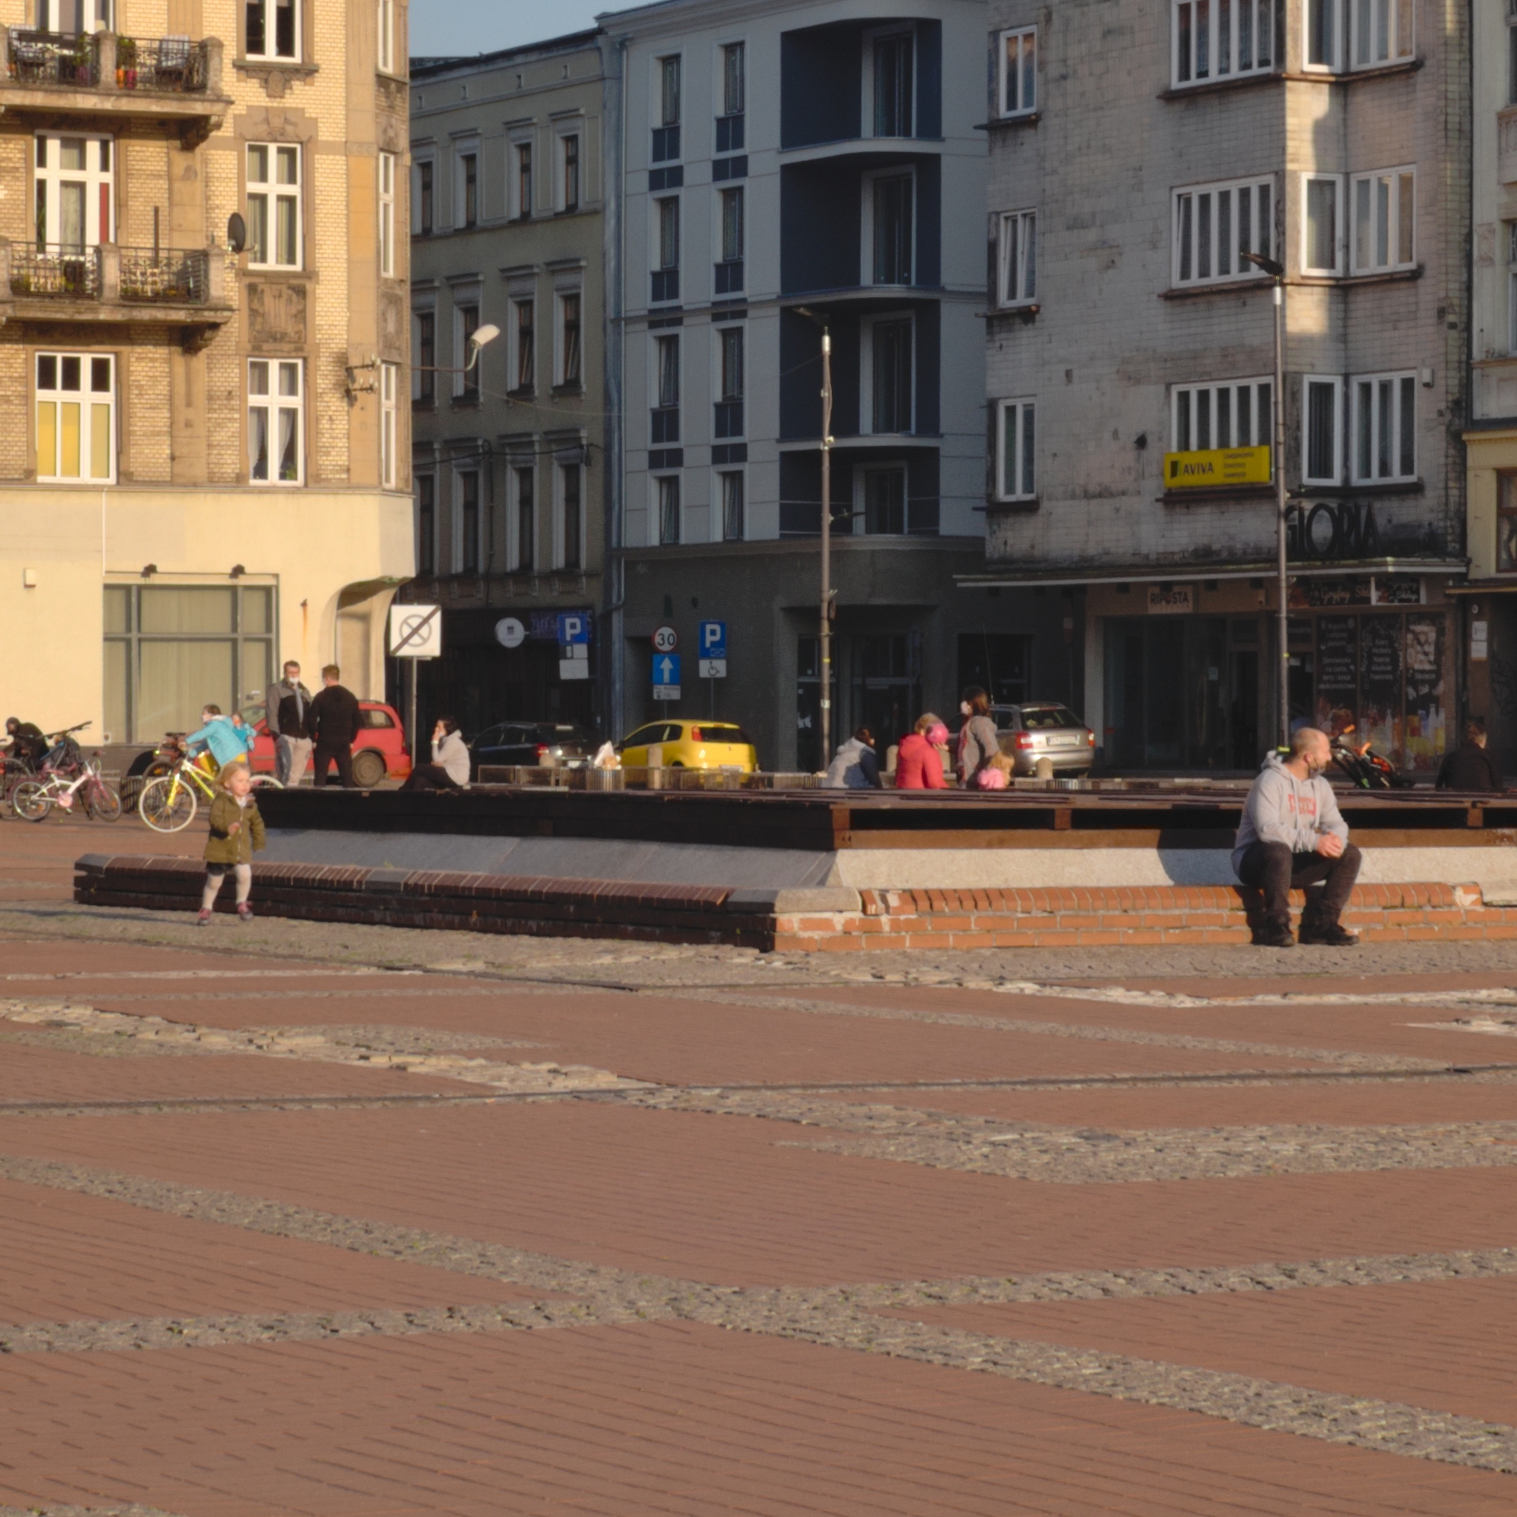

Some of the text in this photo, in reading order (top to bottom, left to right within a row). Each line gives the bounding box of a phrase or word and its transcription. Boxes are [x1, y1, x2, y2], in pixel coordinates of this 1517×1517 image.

[1183, 462, 1214, 475] AVIVA
[1150, 591, 1189, 605] RIPOSTA
[565, 617, 581, 641] P
[705, 624, 721, 648] P
[657, 633, 676, 646] 30
